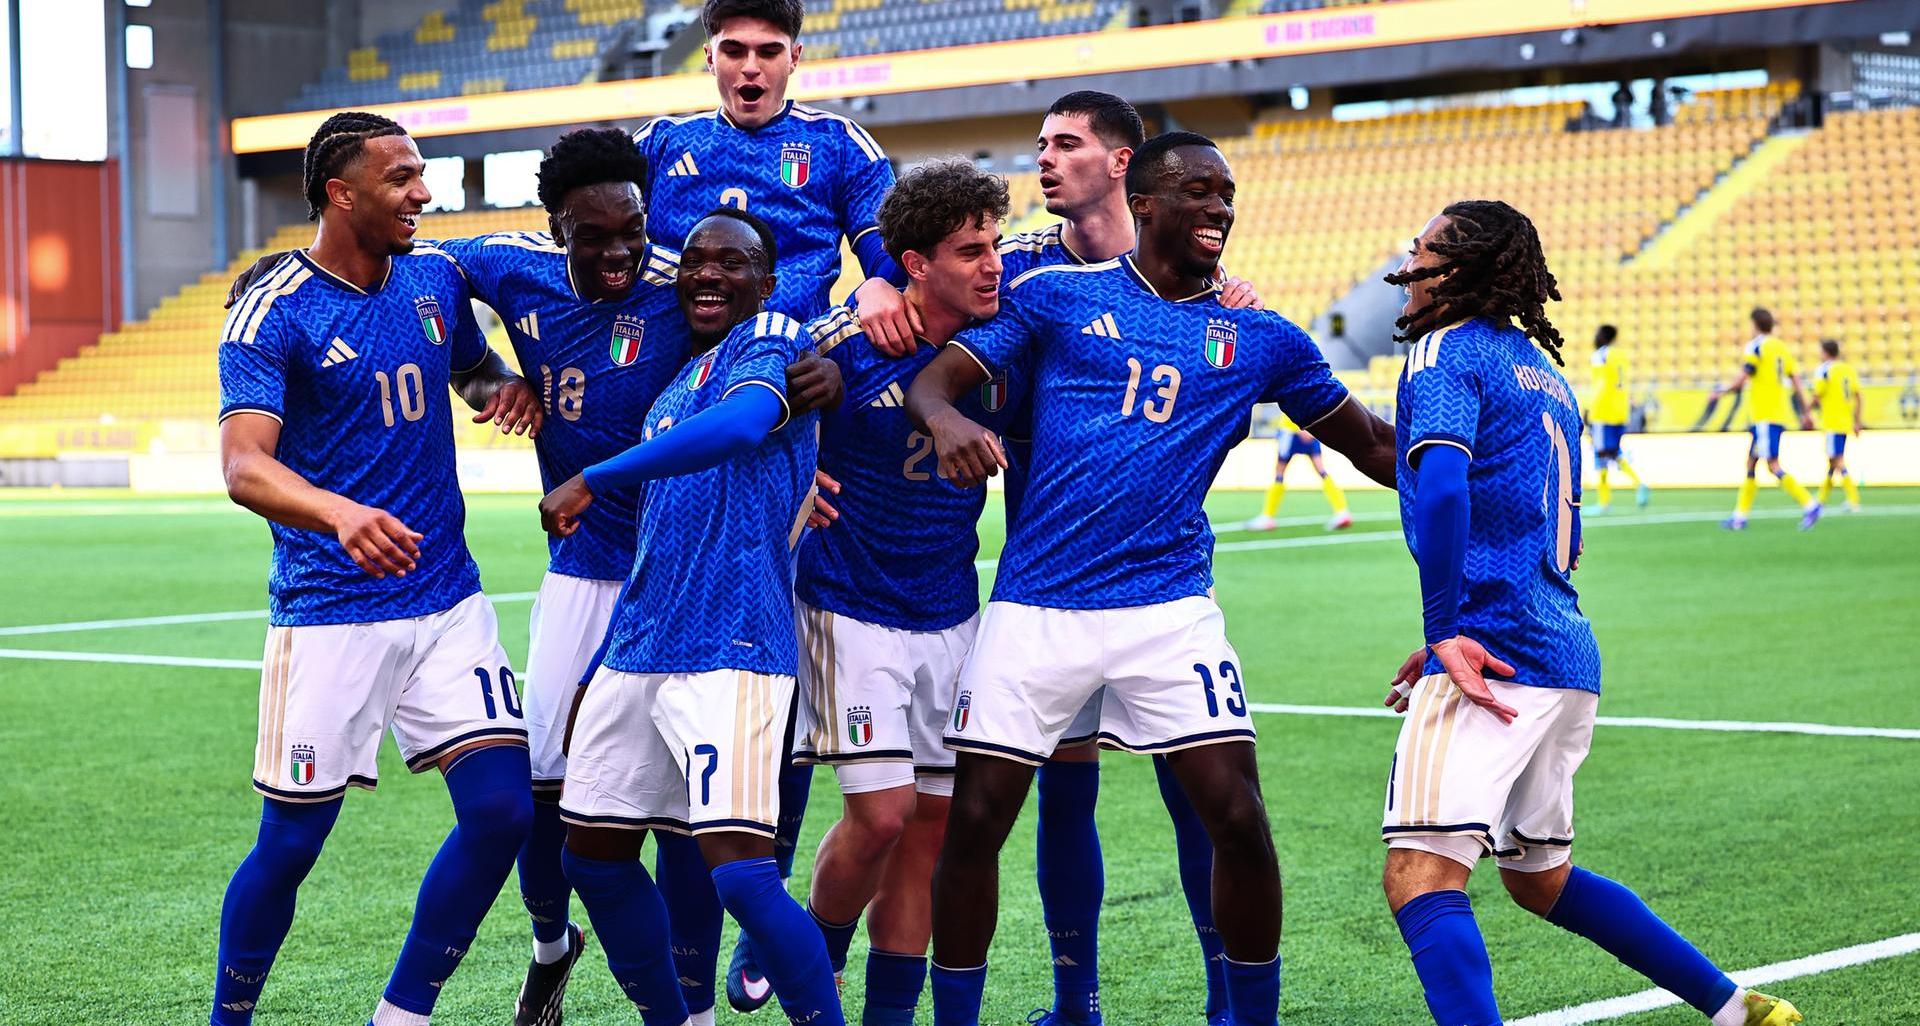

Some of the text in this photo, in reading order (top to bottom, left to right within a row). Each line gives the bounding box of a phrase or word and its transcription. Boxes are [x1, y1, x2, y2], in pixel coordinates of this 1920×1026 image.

[783, 151, 808, 161] ITALIA
[420, 305, 439, 317] ITALIA
[615, 325, 640, 338] ITALIA
[1209, 329, 1234, 341] ITALIA
[375, 363, 425, 427] 10
[541, 364, 585, 421] 18
[1121, 357, 1181, 423] 13
[903, 430, 948, 480] 2
[474, 666, 523, 719] 10
[1193, 660, 1246, 717] 13
